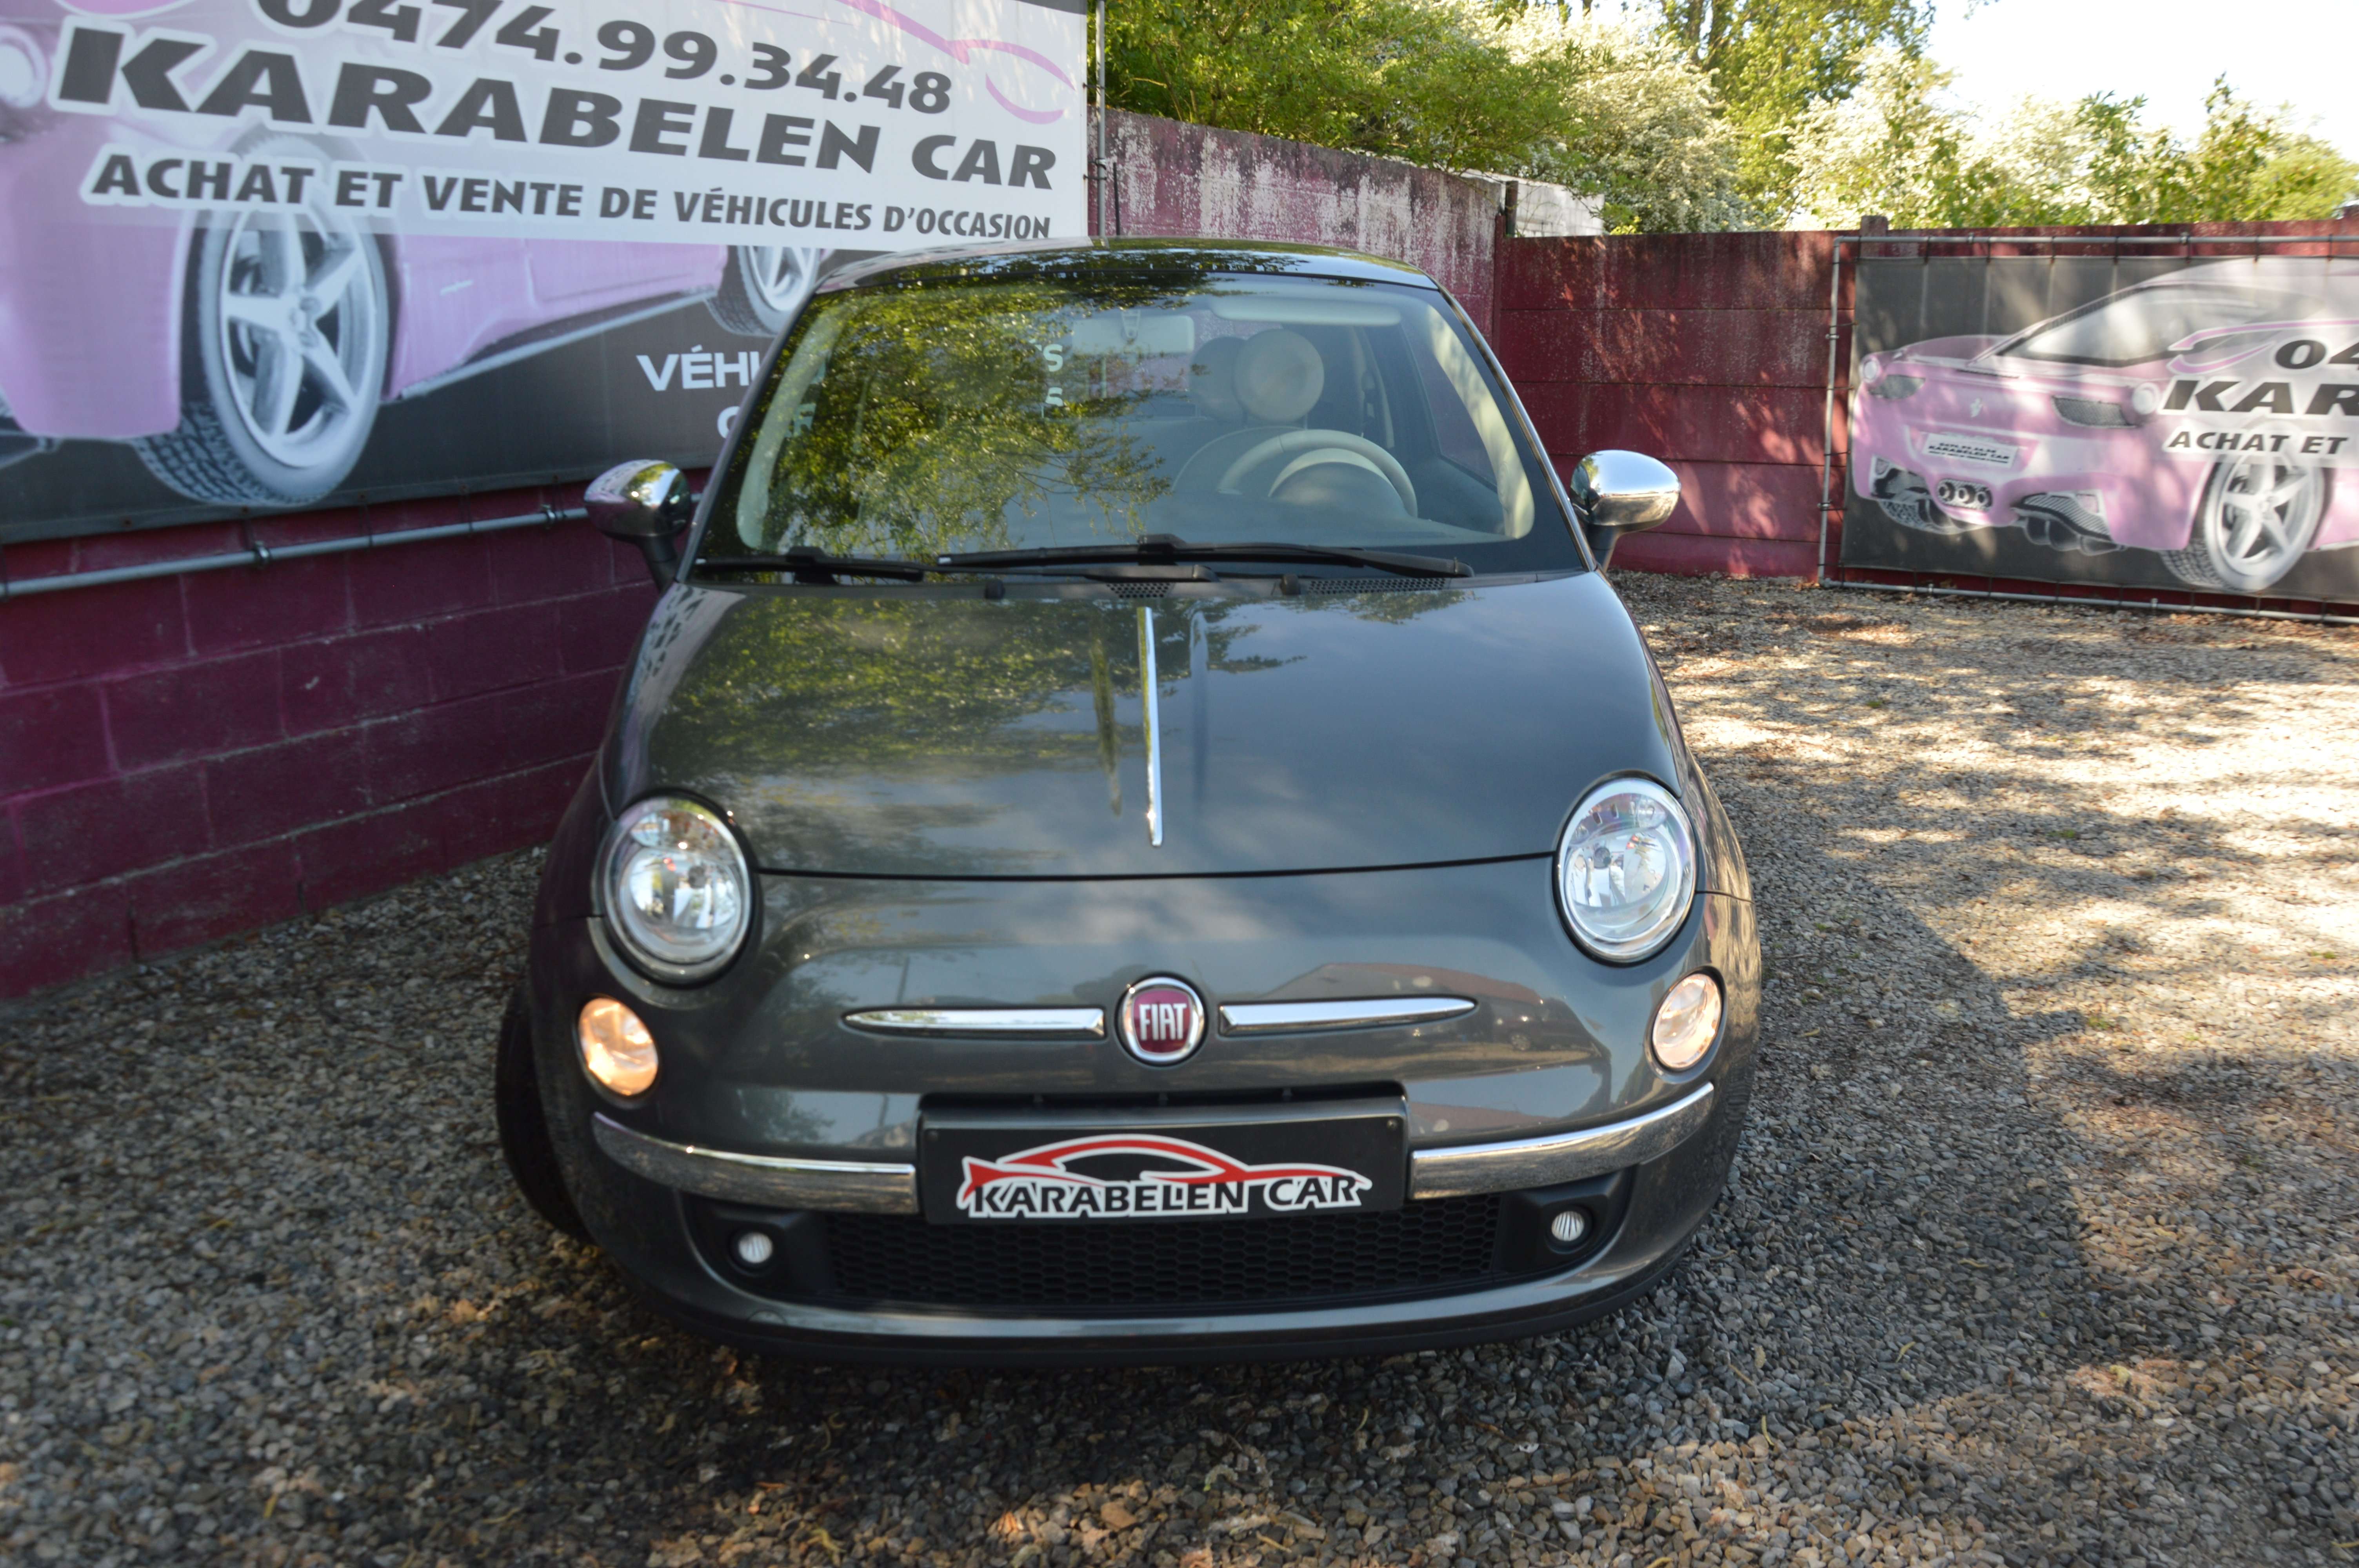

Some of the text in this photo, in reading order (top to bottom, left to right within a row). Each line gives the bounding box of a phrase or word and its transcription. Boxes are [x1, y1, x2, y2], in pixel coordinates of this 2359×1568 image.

[59, 27, 1056, 189] KARABELEN CAR
[91, 154, 1050, 238] ACHAT ET VENTE DE VÉHICULES D'OCCASION
[2169, 432, 2347, 454] ACHAT ET
[1140, 1004, 1187, 1040] FIAT
[974, 1177, 1357, 1213] KARABELEN CAR
